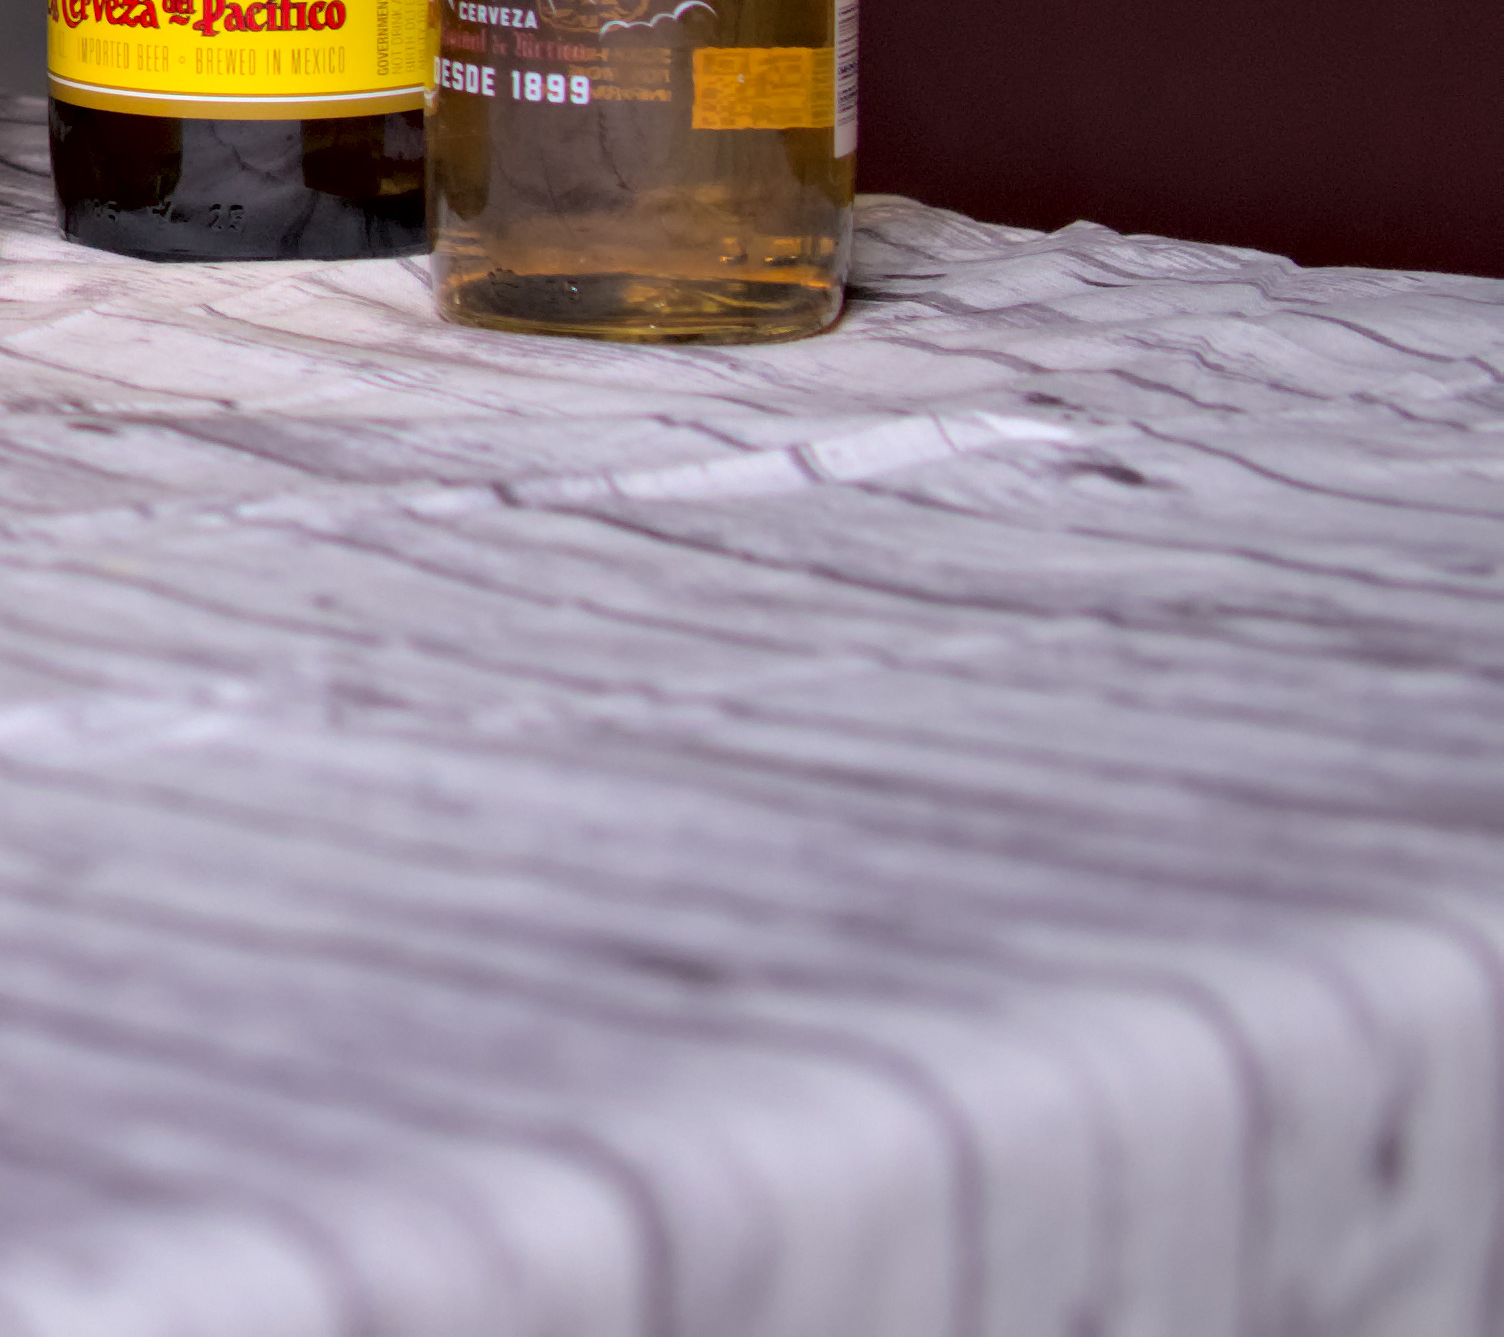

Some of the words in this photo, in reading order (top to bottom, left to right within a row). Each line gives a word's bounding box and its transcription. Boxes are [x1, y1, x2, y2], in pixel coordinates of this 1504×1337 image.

[391, 9, 403, 46] DRINK
[458, 0, 539, 30] CERVEZA
[77, 36, 130, 70] IMPORTED
[137, 43, 169, 73] BEER
[195, 47, 257, 76] BREWED
[266, 47, 282, 76] IN
[291, 46, 346, 76] MEXICO
[391, 51, 403, 75] NOT
[433, 55, 497, 98] DESDE
[510, 68, 591, 106] 1899
